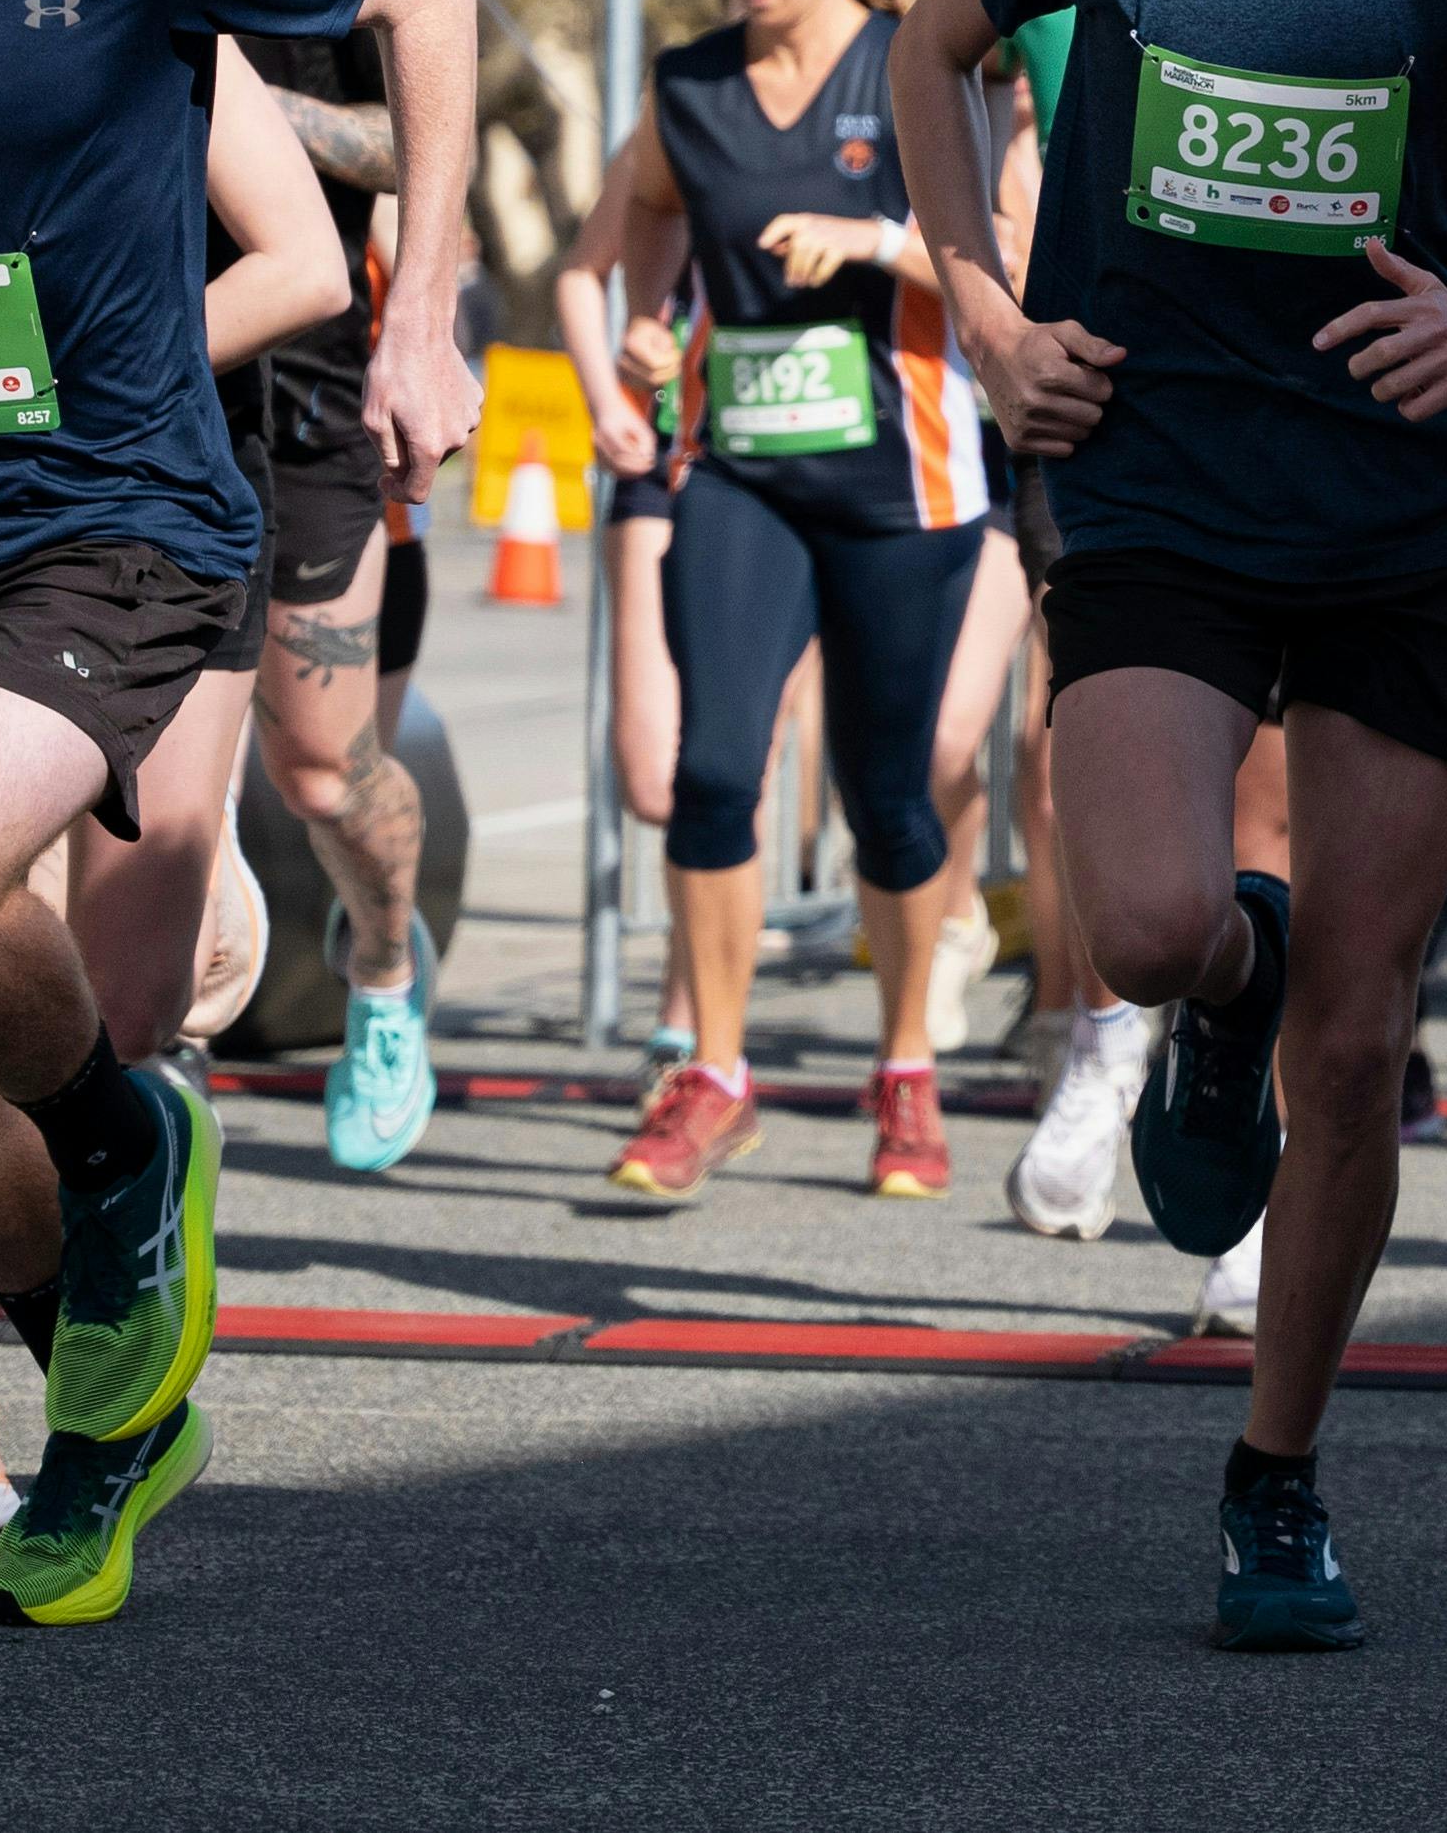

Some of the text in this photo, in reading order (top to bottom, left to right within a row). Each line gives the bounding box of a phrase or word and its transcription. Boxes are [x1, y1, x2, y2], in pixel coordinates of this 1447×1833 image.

[1346, 95, 1377, 106] 5km
[1178, 104, 1358, 182] 8236
[1354, 234, 1386, 248] 826
[17, 410, 51, 425] 8257
